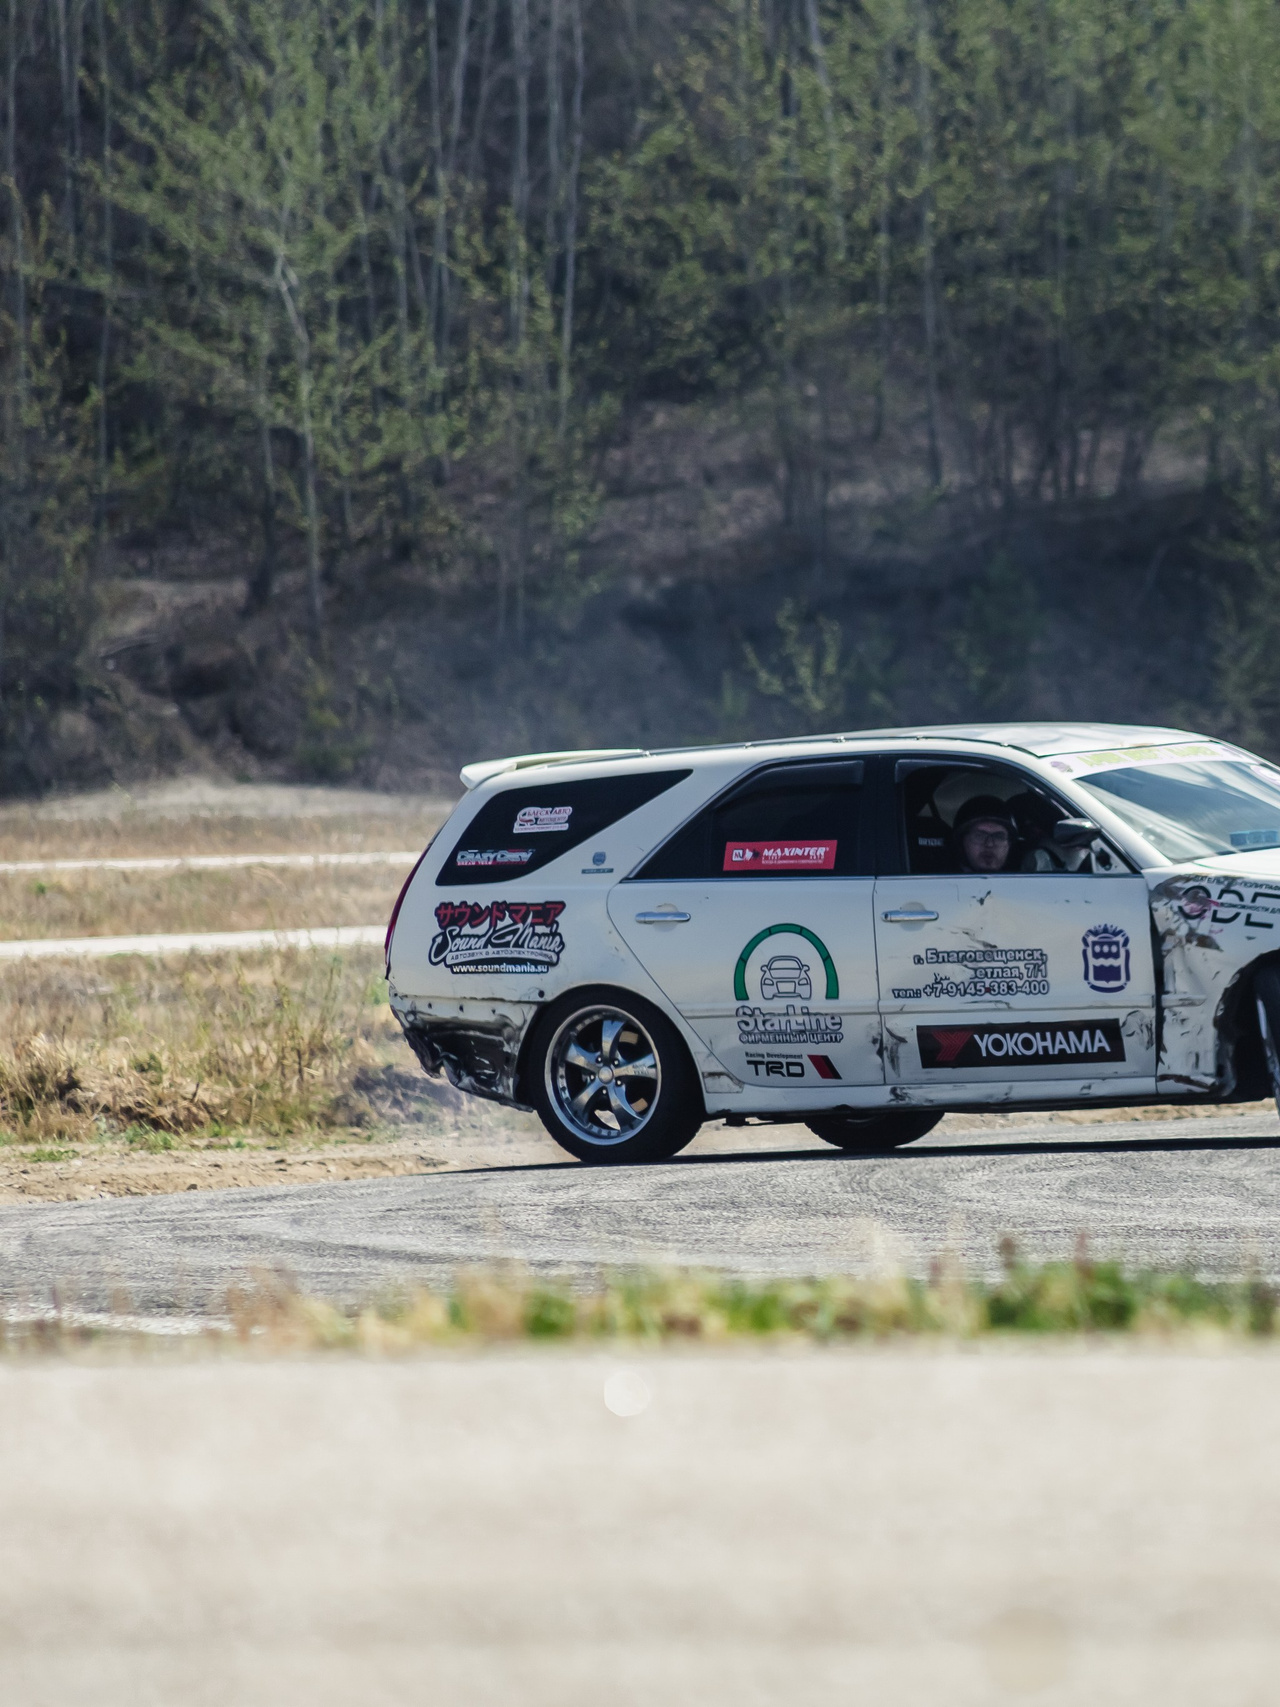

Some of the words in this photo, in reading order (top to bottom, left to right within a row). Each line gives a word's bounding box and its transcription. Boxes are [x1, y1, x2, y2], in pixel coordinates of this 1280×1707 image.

[762, 847, 827, 857] MAXINTER
[436, 902, 566, 927] サウンドマニア
[430, 925, 494, 962] Sound
[491, 911, 563, 953] Mania
[913, 954, 925, 965] г.
[926, 948, 1048, 964] Благовещенск,
[452, 961, 548, 974] www.soundmania.su
[1024, 963, 1048, 978] 7/1
[892, 988, 922, 998] тел.:
[922, 980, 1049, 997] +7-9145-383-400
[735, 1004, 843, 1032] StarLine
[808, 1031, 844, 1044] ЦЕНТР
[973, 1029, 1111, 1057] YOKOHAMA
[745, 1051, 766, 1059] Racing
[766, 1051, 803, 1060] Development
[746, 1059, 805, 1078] TRD
